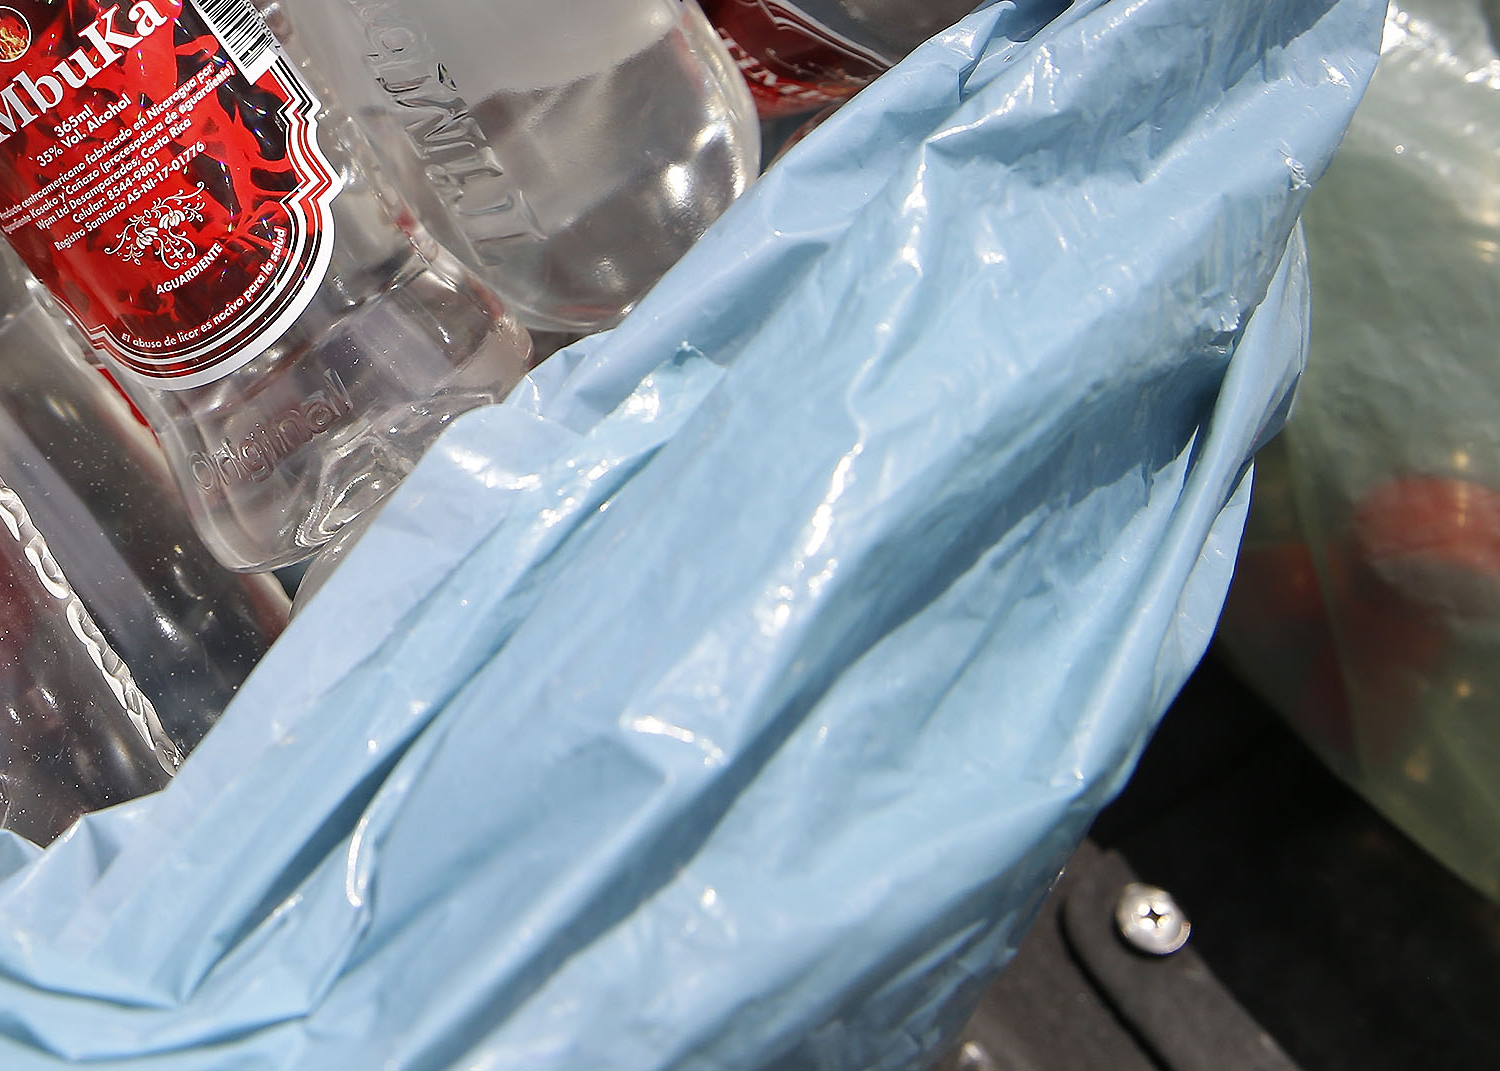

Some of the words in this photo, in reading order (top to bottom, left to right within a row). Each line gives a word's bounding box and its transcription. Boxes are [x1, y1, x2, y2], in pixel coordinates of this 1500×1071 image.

[22, 163, 85, 208] centroamericano
[85, 129, 132, 164] fabricado
[134, 117, 147, 130] en
[146, 79, 197, 120] Nicaragua
[197, 62, 214, 84] por
[29, 198, 58, 218] Kosako
[56, 190, 66, 204] y
[64, 169, 99, 195] Cañazo
[100, 122, 163, 173] (procesadora
[165, 112, 178, 124] de
[179, 64, 235, 113] aguardiente)
[36, 215, 57, 229] Wpm
[55, 204, 69, 218] Ltd
[141, 136, 169, 158] Costa
[169, 119, 191, 138] Rica
[37, 145, 63, 166] 35%
[61, 130, 86, 147] Vol.
[87, 94, 131, 132] Alcohol
[53, 103, 94, 138] 365ml
[54, 229, 85, 250] Registro
[85, 202, 125, 231] Sanitario
[127, 141, 204, 204] AS-NI-17-01776
[73, 198, 106, 222] Celular:
[103, 158, 159, 200] 8544-9801
[121, 332, 130, 343] El
[132, 338, 162, 348] abuso
[164, 333, 176, 347] de
[177, 328, 200, 343] licor
[200, 321, 213, 332] es
[213, 297, 245, 325] nocivo
[244, 274, 266, 302] para
[259, 262, 274, 276] la
[271, 227, 287, 261] salud
[156, 242, 223, 295] AGUARDIENTE
